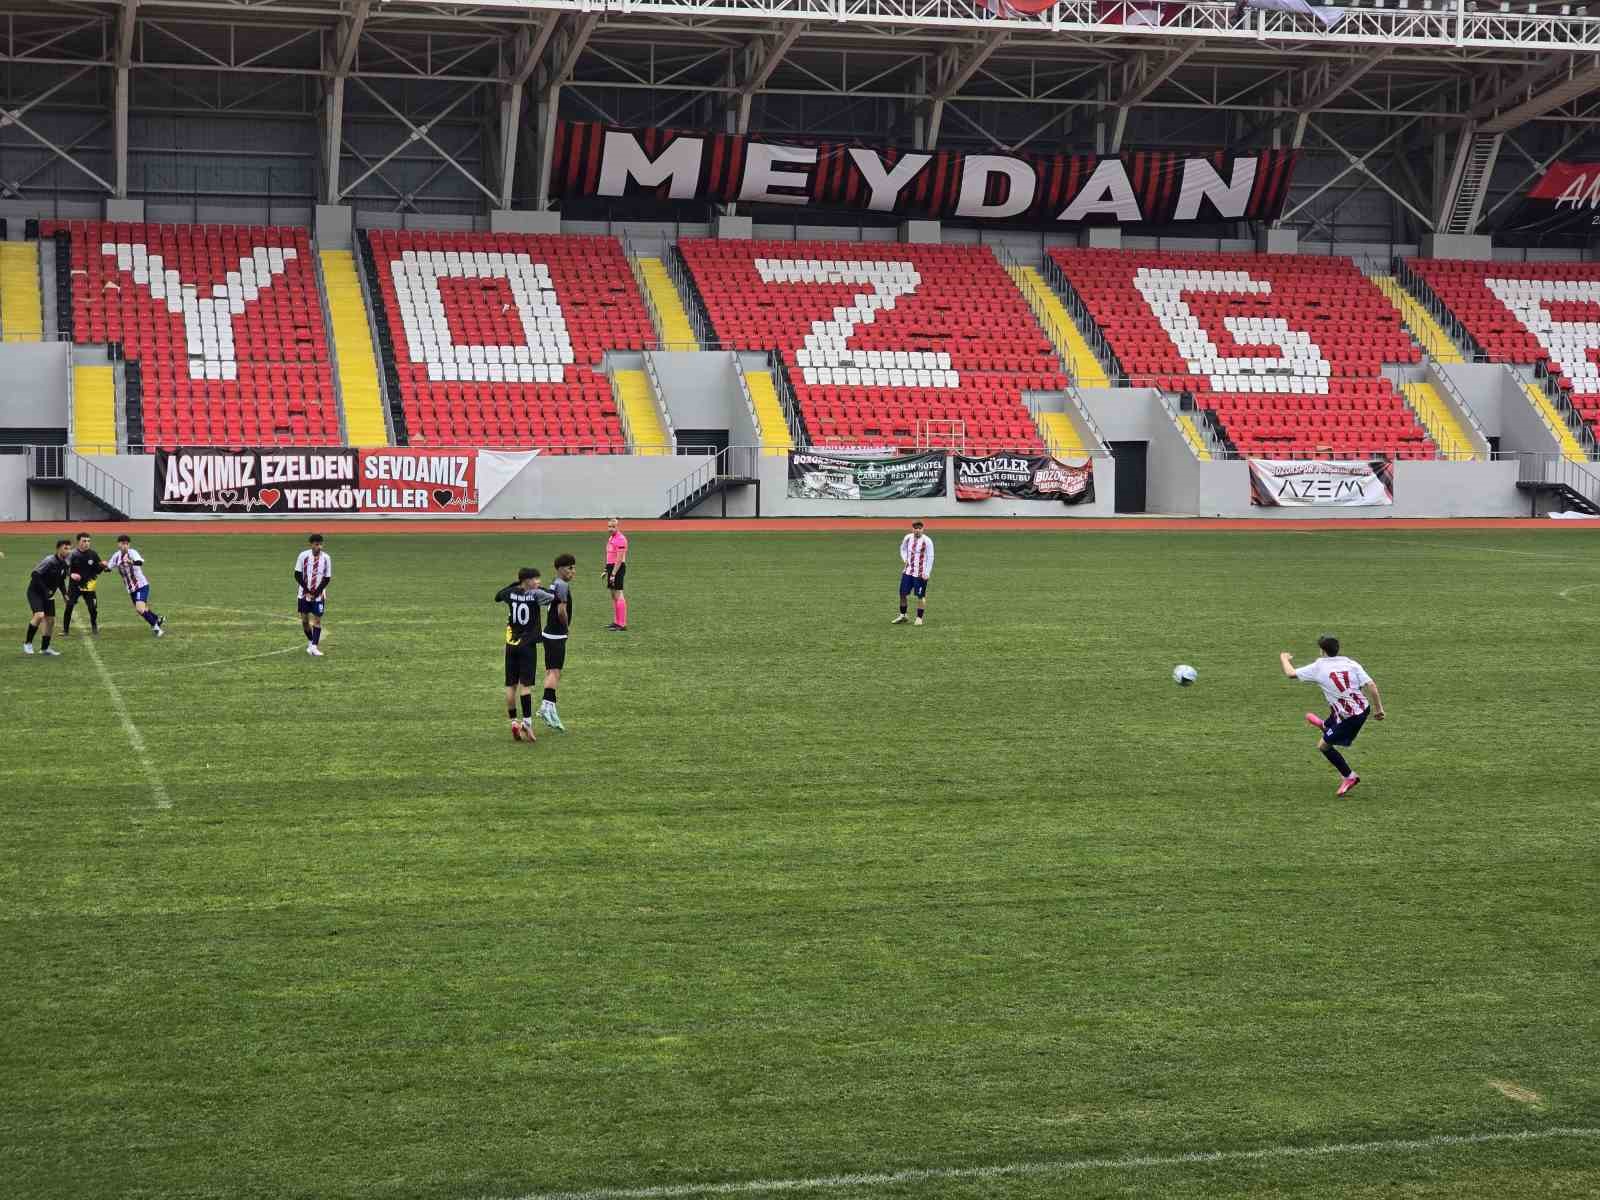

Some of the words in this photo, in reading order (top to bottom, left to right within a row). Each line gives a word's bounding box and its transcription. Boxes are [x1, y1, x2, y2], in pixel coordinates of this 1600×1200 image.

[597, 130, 1258, 222] MEYDAN
[891, 470, 938, 479] RESTAURANT
[959, 457, 1031, 476] AKYÜZLER
[1001, 473, 1031, 482] GRUBU
[164, 454, 255, 503] AŞKIMIZ
[261, 455, 353, 485] EZELDEN
[364, 455, 469, 488] SEVDAMIZ
[1278, 480, 1365, 498] AZEM
[284, 485, 428, 509] YERKÖYLÜLER
[511, 601, 530, 625] 10
[1329, 671, 1350, 693] 17
